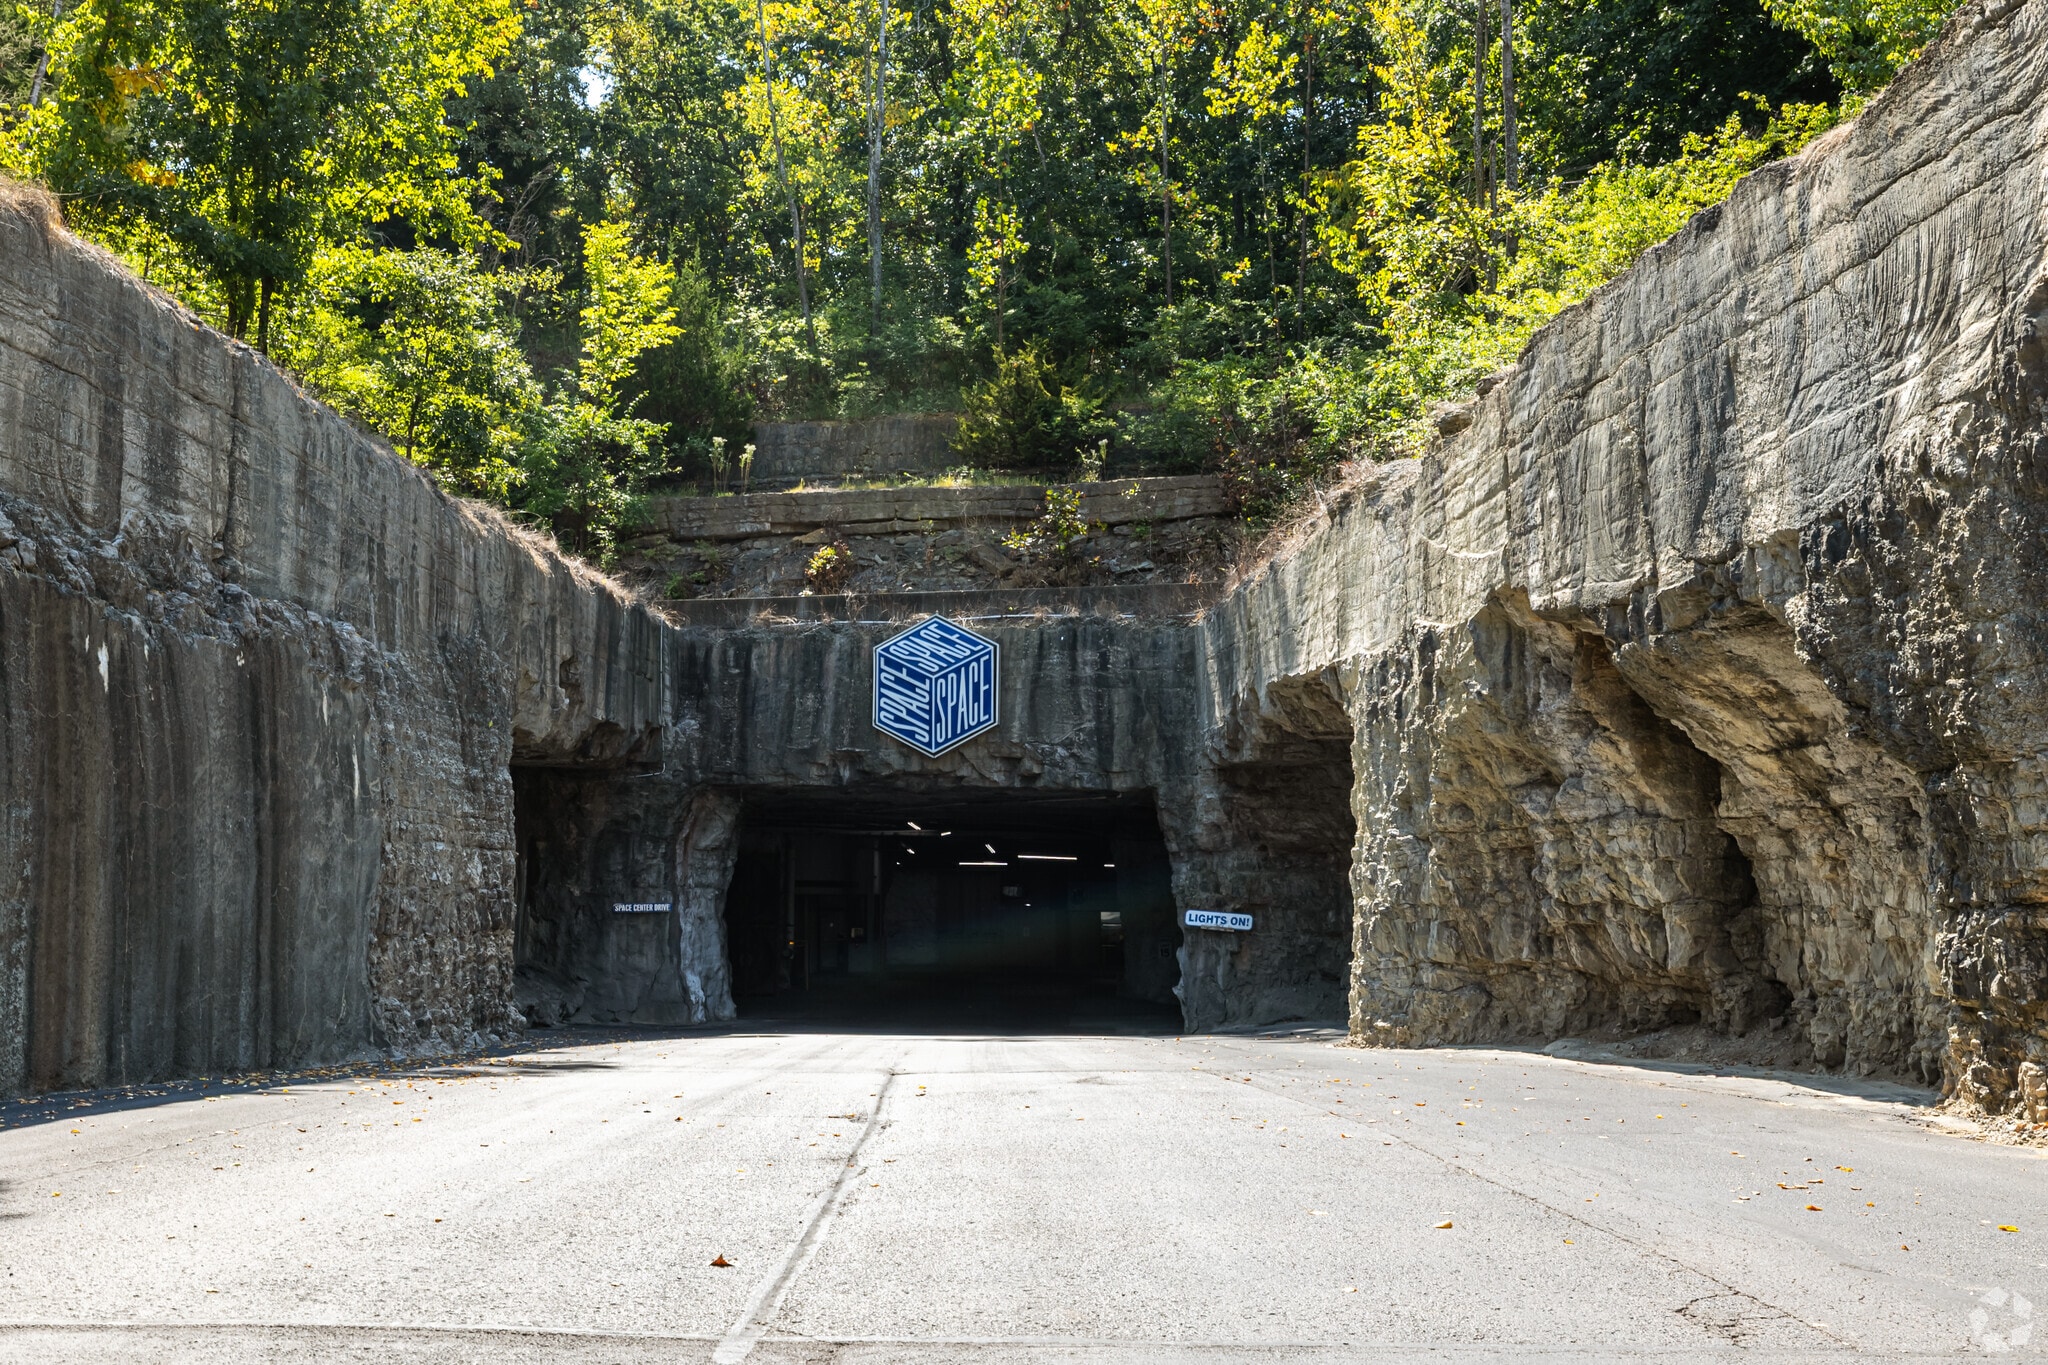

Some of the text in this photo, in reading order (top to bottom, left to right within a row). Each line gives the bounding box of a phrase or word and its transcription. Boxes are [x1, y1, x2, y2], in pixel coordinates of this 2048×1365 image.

[889, 623, 984, 672] SPACE
[880, 657, 930, 743] SPACE
[936, 655, 989, 743] SPACE
[614, 904, 632, 912] SPACE
[633, 904, 653, 912] CENTER
[1188, 913, 1250, 927] LIGHTS ON!
